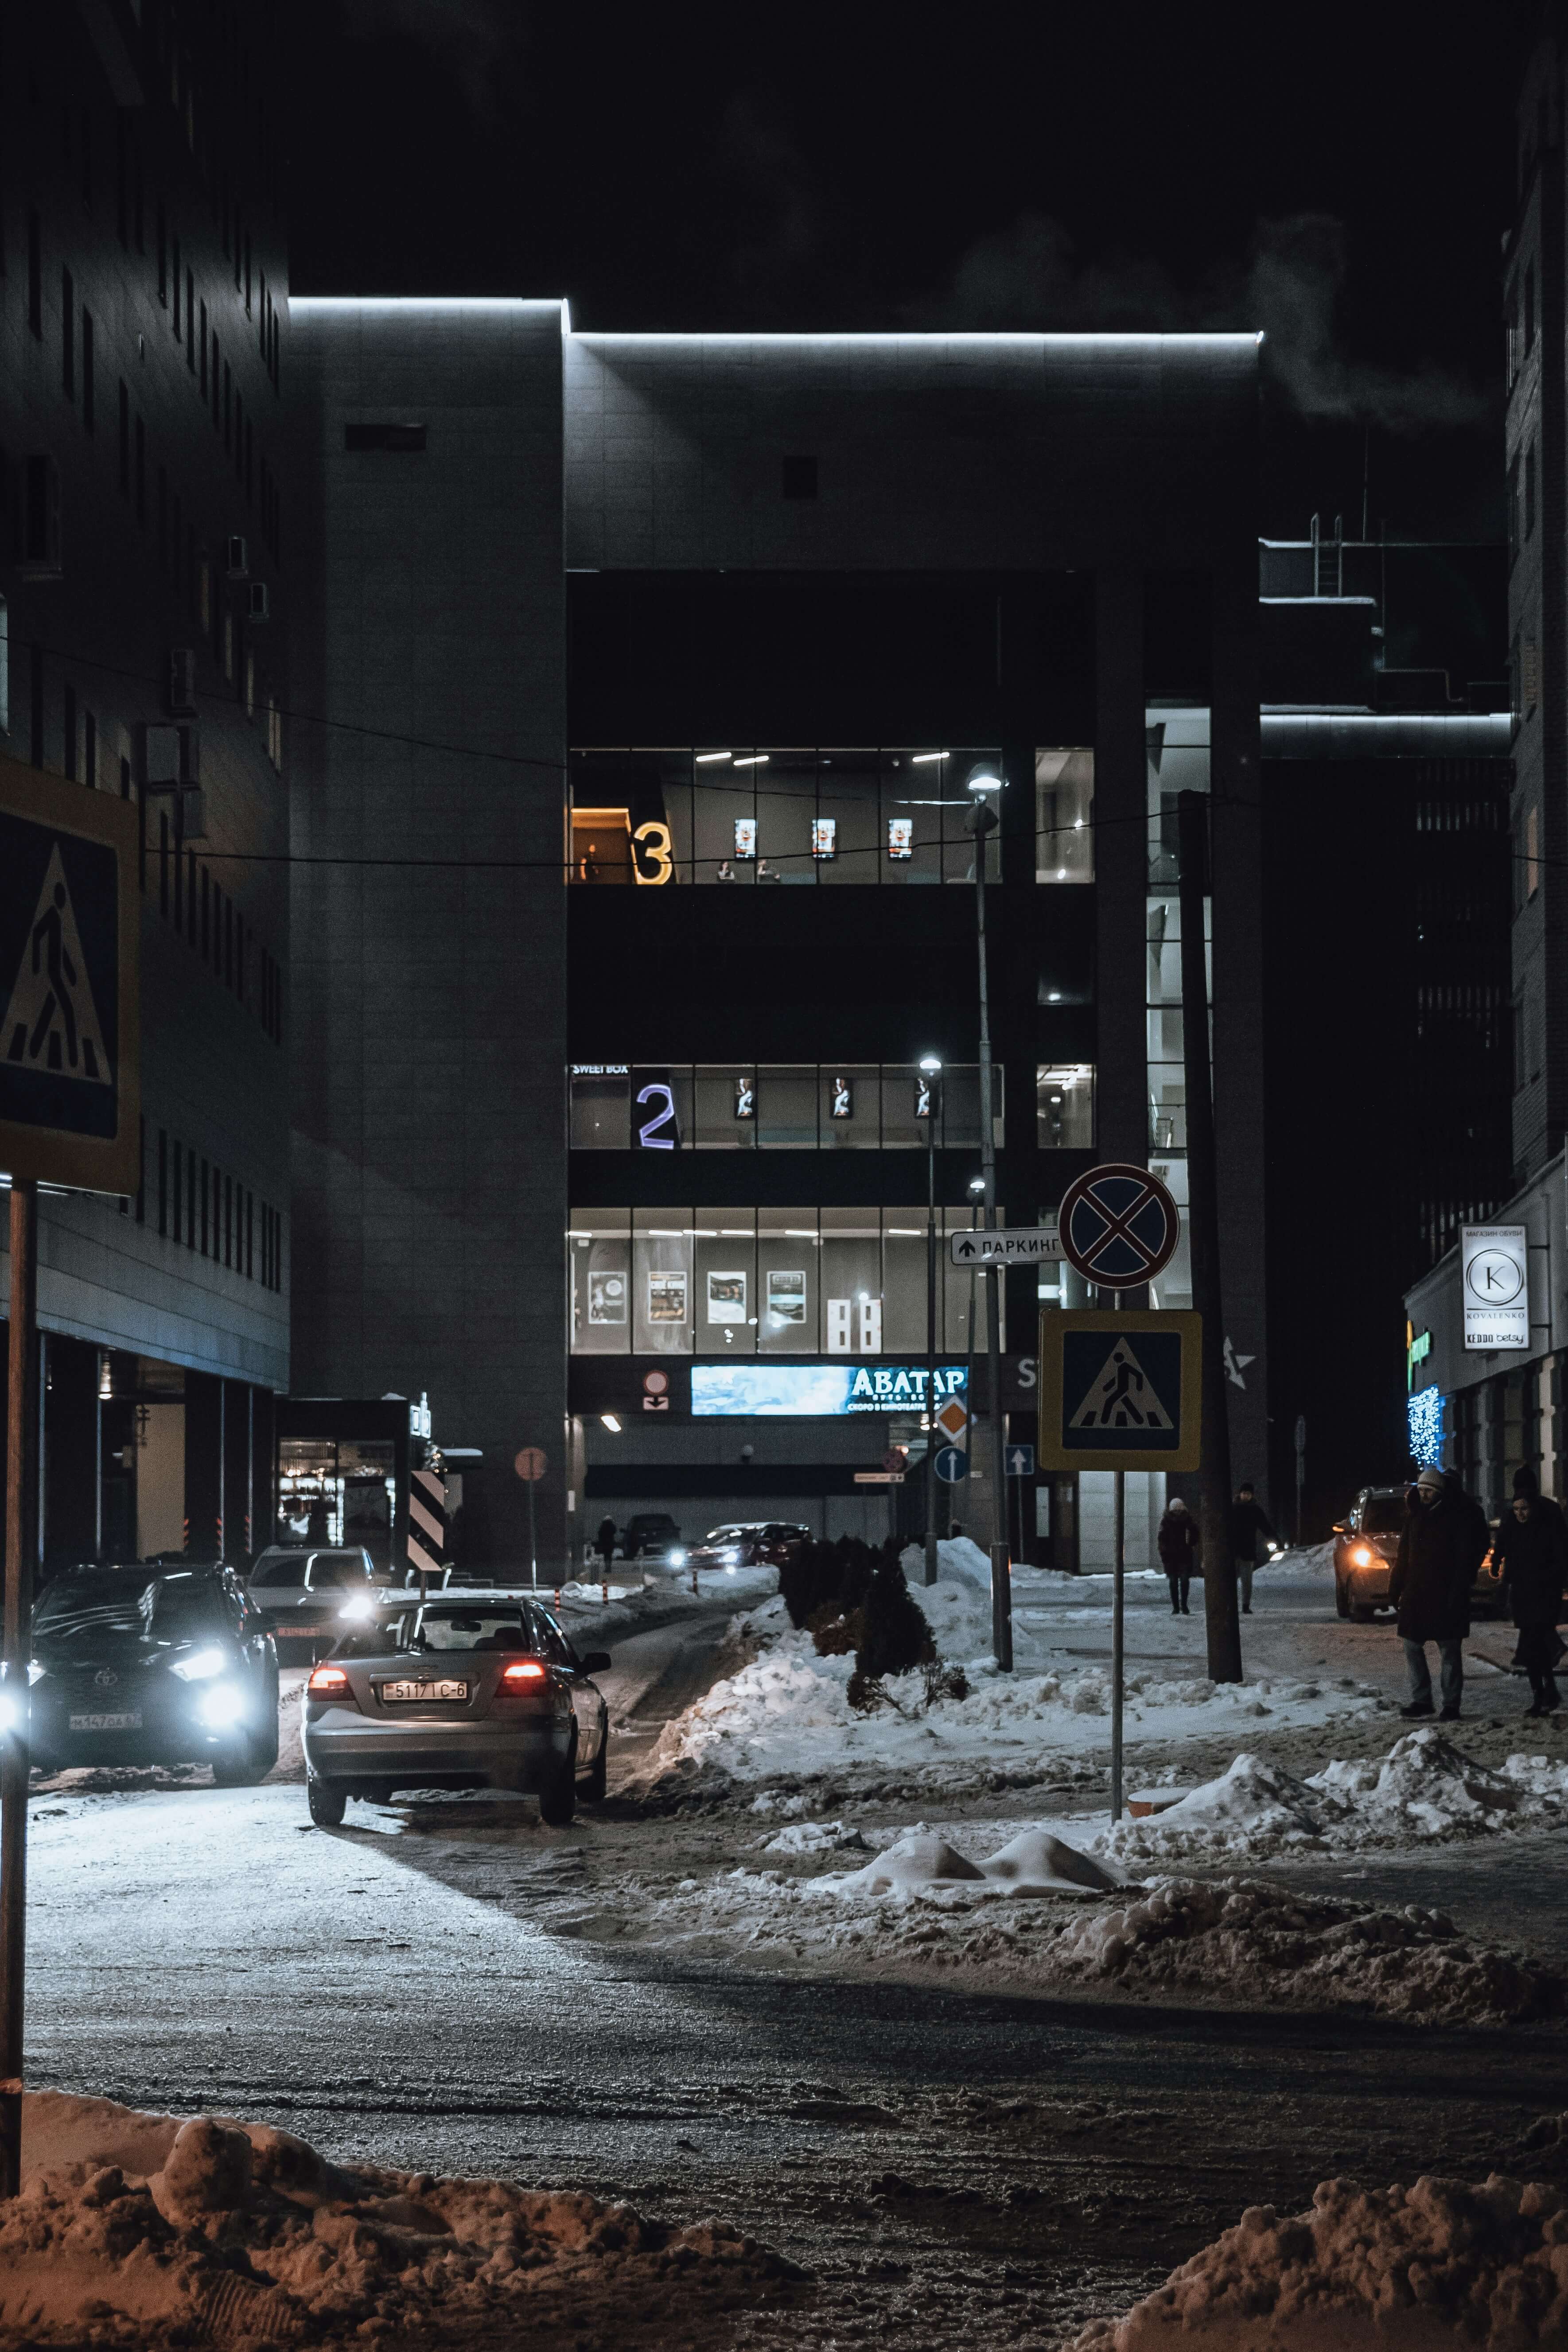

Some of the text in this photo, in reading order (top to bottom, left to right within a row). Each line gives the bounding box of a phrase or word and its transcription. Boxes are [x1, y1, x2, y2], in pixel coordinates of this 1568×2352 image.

[633, 821, 673, 884] 3
[636, 1083, 674, 1150] 2
[982, 1239, 1060, 1254] ПАРКИНГ
[1484, 1266, 1506, 1290] K
[1467, 1333, 1523, 1344] KEDDO betsy
[852, 1368, 965, 1395] АВАТАР
